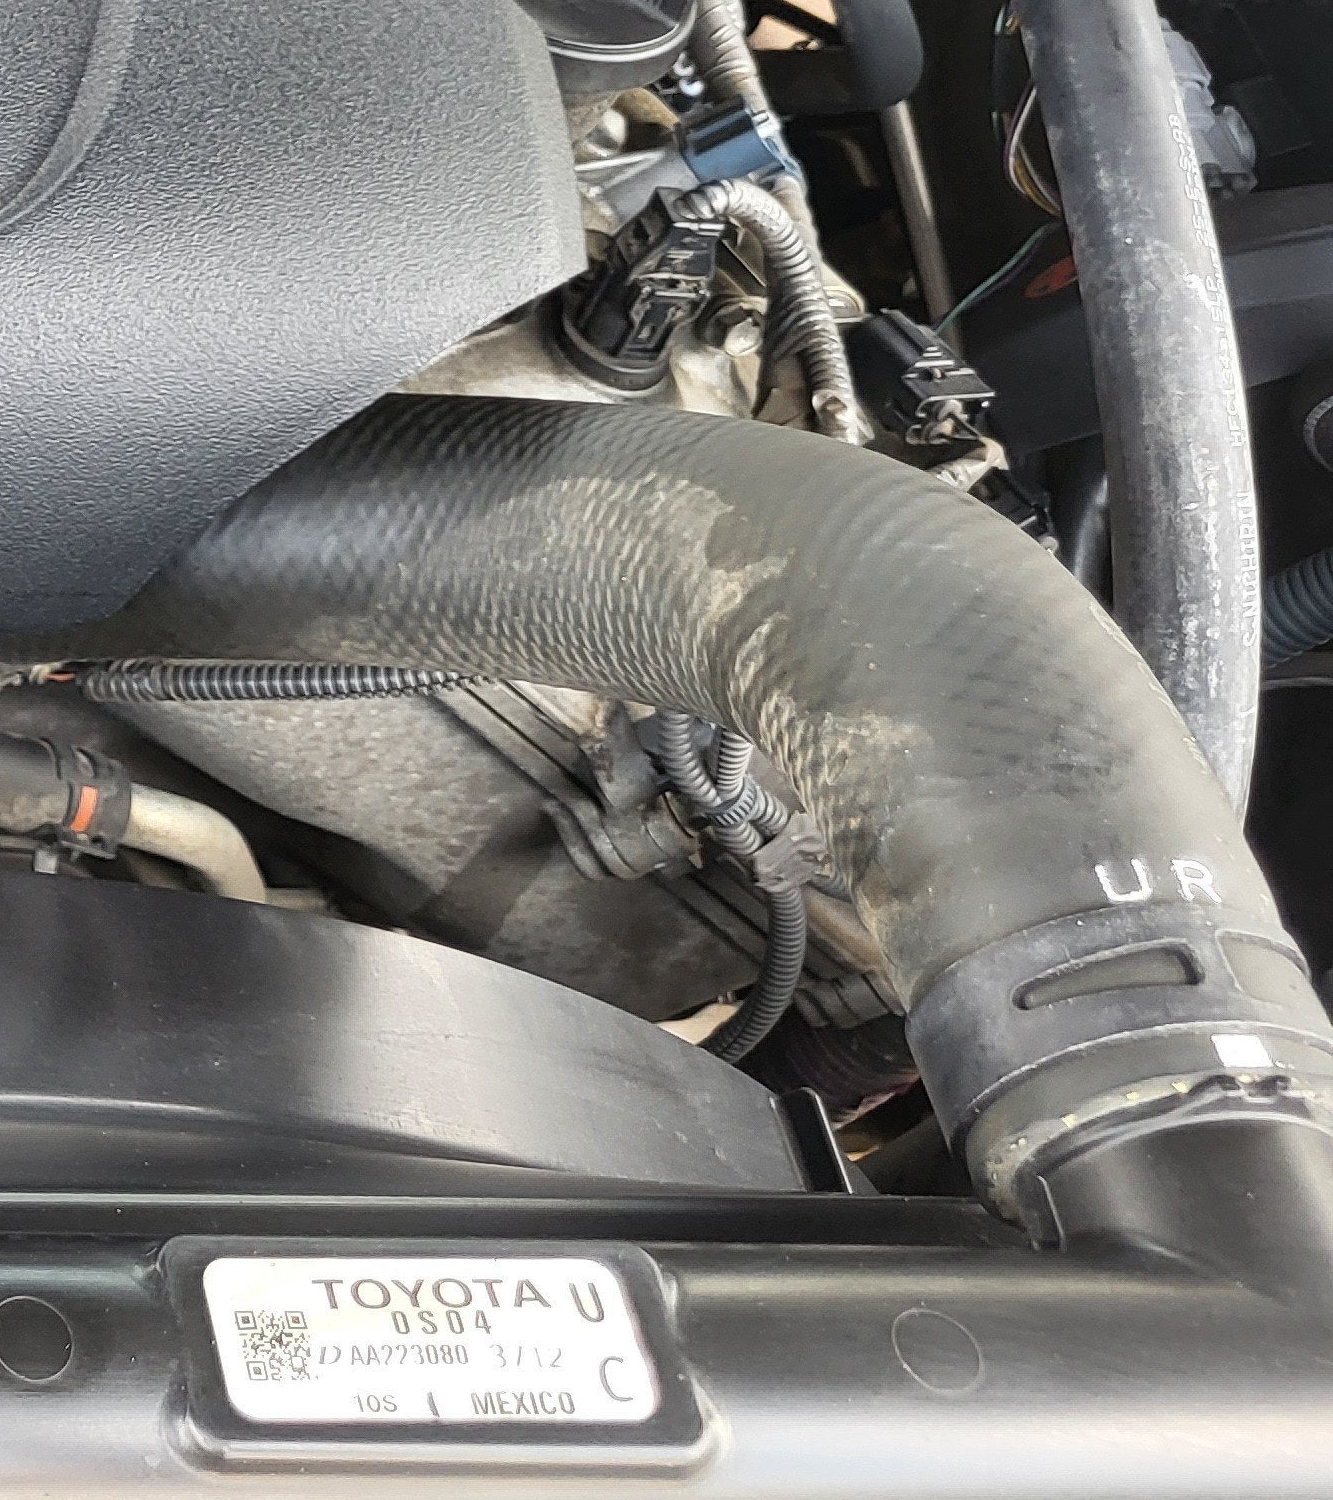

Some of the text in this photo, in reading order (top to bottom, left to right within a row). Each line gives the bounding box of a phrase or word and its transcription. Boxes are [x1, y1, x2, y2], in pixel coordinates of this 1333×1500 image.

[312, 1278, 551, 1310] TOYOTA
[568, 1282, 605, 1323] U
[599, 1355, 634, 1402] C
[470, 1391, 576, 1415] MEXICO
